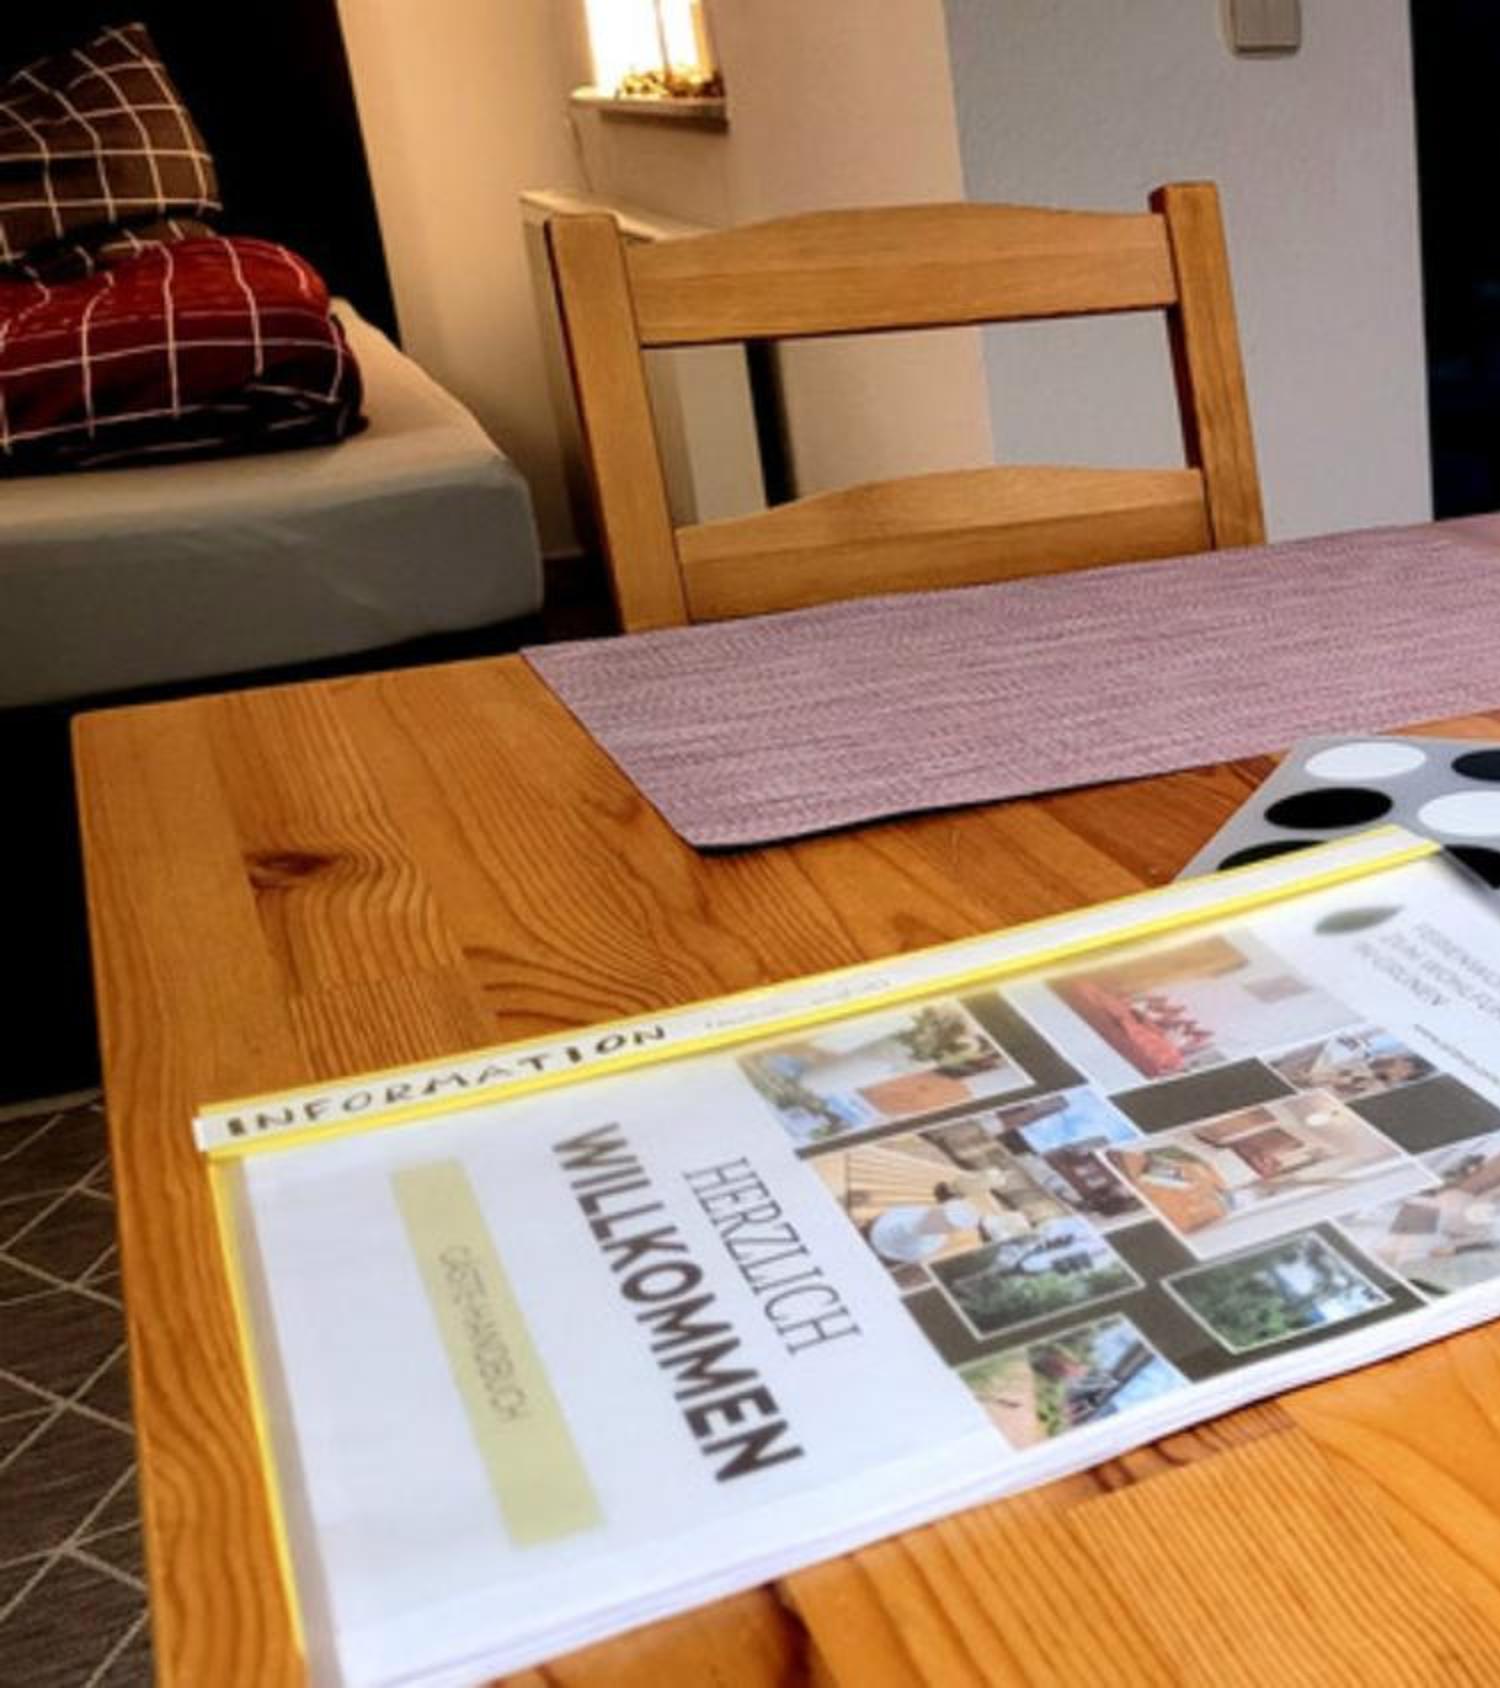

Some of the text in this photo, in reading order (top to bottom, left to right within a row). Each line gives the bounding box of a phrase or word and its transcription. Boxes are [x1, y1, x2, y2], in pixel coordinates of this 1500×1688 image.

[227, 1023, 667, 1137] INFORMATION
[552, 1122, 805, 1483] WILLKOMMEN
[682, 1157, 862, 1355] HERZLICH
